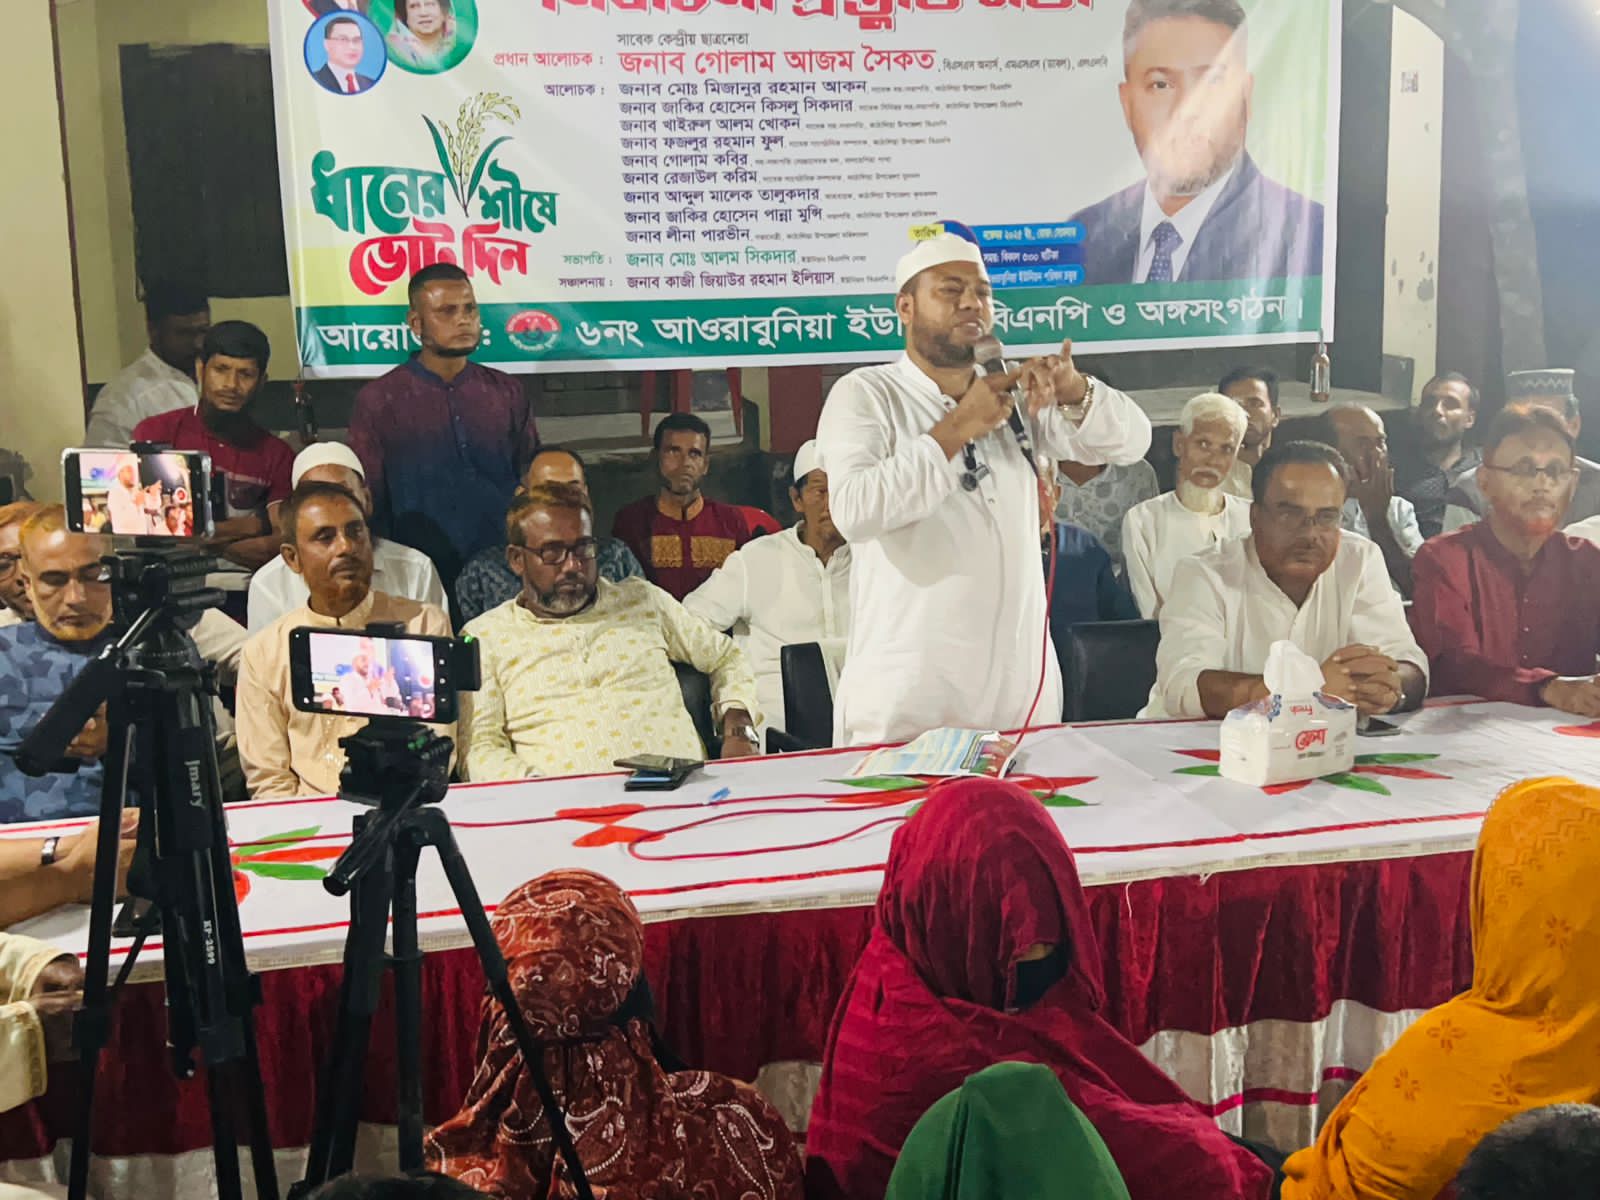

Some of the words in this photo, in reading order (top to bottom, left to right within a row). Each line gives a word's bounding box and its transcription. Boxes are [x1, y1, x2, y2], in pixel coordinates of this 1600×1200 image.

[617, 33, 653, 46] সাবেক
[658, 29, 696, 47] কেন্দ্রীয়
[701, 31, 749, 46] ছাত্রনেতা
[494, 52, 529, 67] প্রধান
[534, 51, 593, 67] আলোচক
[618, 51, 687, 75] জনাব
[695, 50, 775, 74] গোলাম
[784, 48, 854, 73] আজম
[543, 83, 596, 97] আলোচক
[618, 83, 662, 96] জনাব
[668, 82, 698, 95] মোঃ
[704, 79, 761, 98] মিজানুর
[767, 80, 816, 94] রহমান
[618, 102, 657, 115] জনাব
[661, 97, 705, 115] জাকির
[709, 100, 757, 114] হোসেন
[619, 119, 657, 133] জনাব
[716, 118, 754, 131] আলম
[620, 137, 658, 150] জনাব
[663, 136, 709, 152] ফজলুর
[713, 136, 755, 151] রহমান
[621, 155, 658, 168] জনাব
[663, 154, 708, 167] গোলাম
[622, 172, 659, 185] জনাব
[664, 169, 718, 184] রেজাউল
[311, 149, 447, 235] ধানের
[479, 158, 560, 233] শীষে
[623, 191, 660, 205] জনাব
[709, 189, 753, 202] মালেক
[624, 211, 661, 224] জনাব
[665, 207, 708, 223] জাকির
[713, 209, 759, 222] হোসেন
[764, 208, 793, 223] পান্না
[625, 230, 662, 243] জনাব
[666, 225, 696, 241] লীনা
[349, 216, 457, 296] ভোট
[462, 221, 532, 286] দিন
[562, 250, 605, 265] সভাপতি
[626, 253, 664, 268] জনাব
[670, 252, 697, 267] মোঃ
[701, 251, 740, 266] আলম
[626, 276, 661, 289] জনাব
[665, 271, 696, 289] কাজী
[700, 271, 746, 288] জিয়াউর
[750, 272, 787, 288] রহমান
[792, 267, 835, 287] ইলিয়াস
[575, 318, 644, 347] ৬নং
[652, 306, 838, 349] আওরাবুনিয়া
[1102, 302, 1127, 326] ও
[184, 760, 206, 809] Jmary
